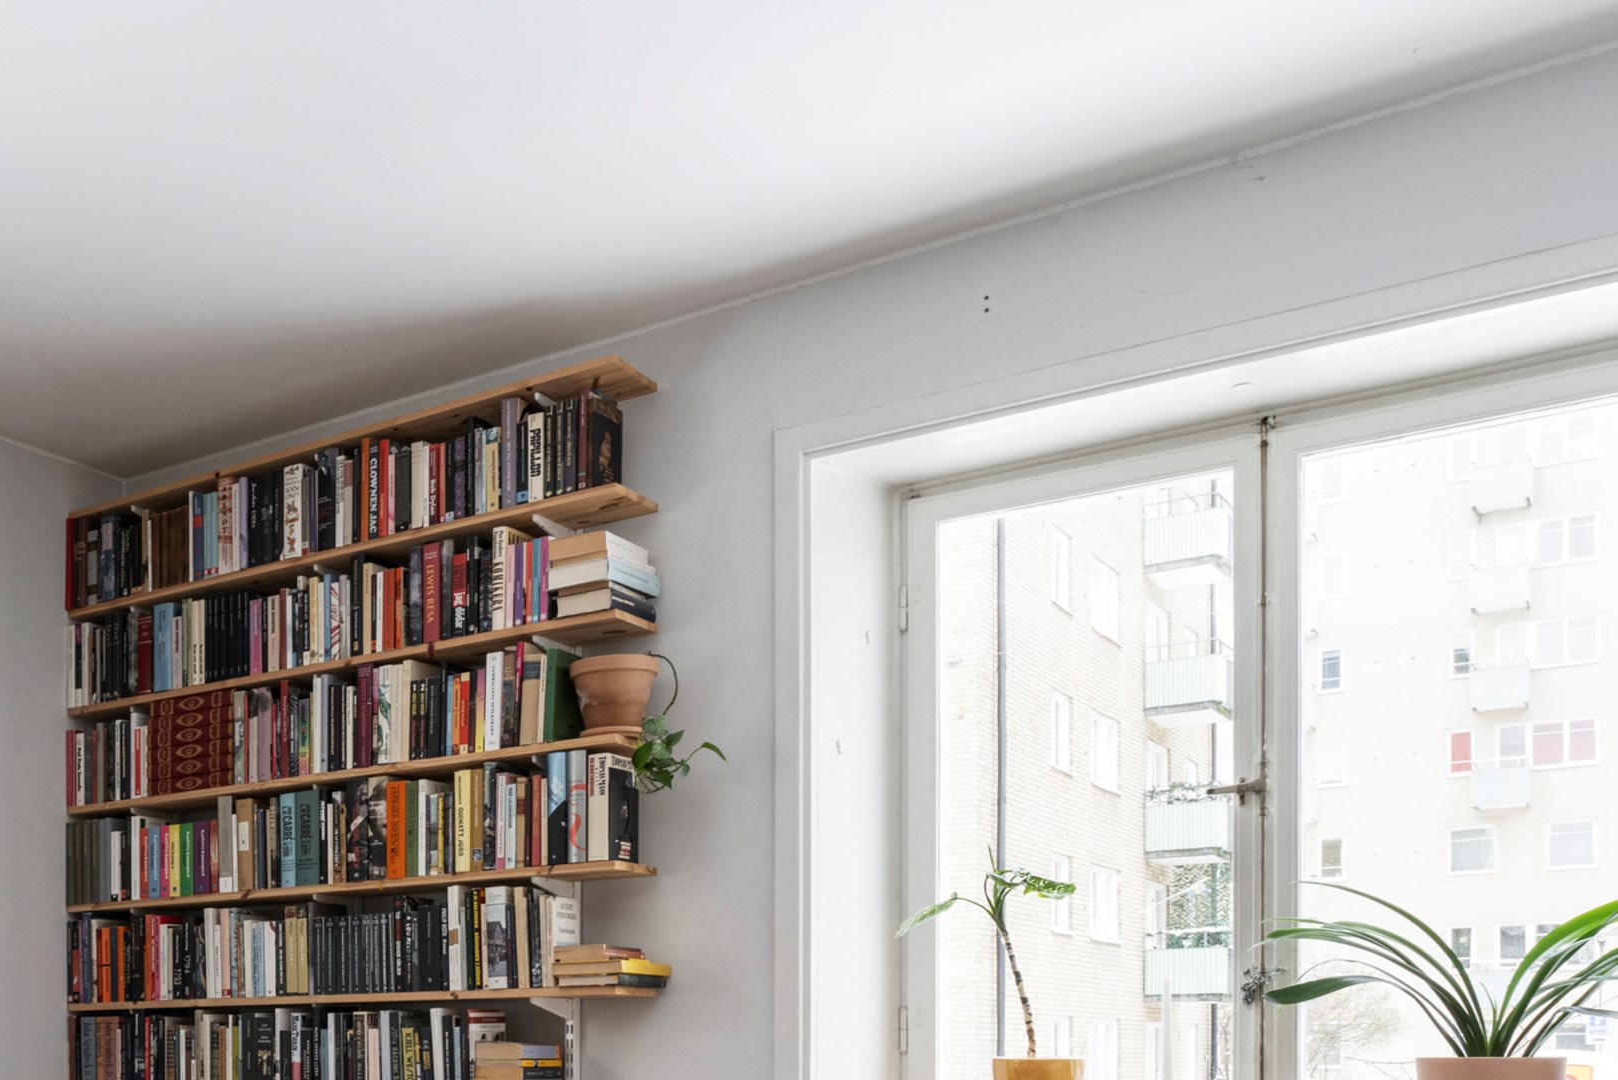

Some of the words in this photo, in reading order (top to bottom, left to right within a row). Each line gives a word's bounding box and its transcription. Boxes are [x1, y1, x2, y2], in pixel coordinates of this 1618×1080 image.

[529, 428, 542, 478] PAPILLON
[369, 457, 379, 512] CLOWNEN
[429, 479, 437, 494] Bob
[429, 495, 437, 516] Dylan
[369, 513, 379, 534] JAC
[427, 564, 436, 595] LEWIS
[453, 592, 466, 607] jag
[427, 598, 436, 624] RESA
[455, 607, 466, 629] dödar
[599, 756, 607, 779] THOMAS
[599, 779, 607, 797] MANN
[282, 815, 296, 842] CARRÉ
[300, 813, 314, 840] CARRÉ
[174, 968, 182, 986] 1793
[83, 1022, 93, 1038] John
[105, 1022, 115, 1037] John
[83, 1039, 93, 1069] Steinbeck
[105, 1038, 115, 1068] Steinbeck
[405, 1032, 414, 1054] KJELL
